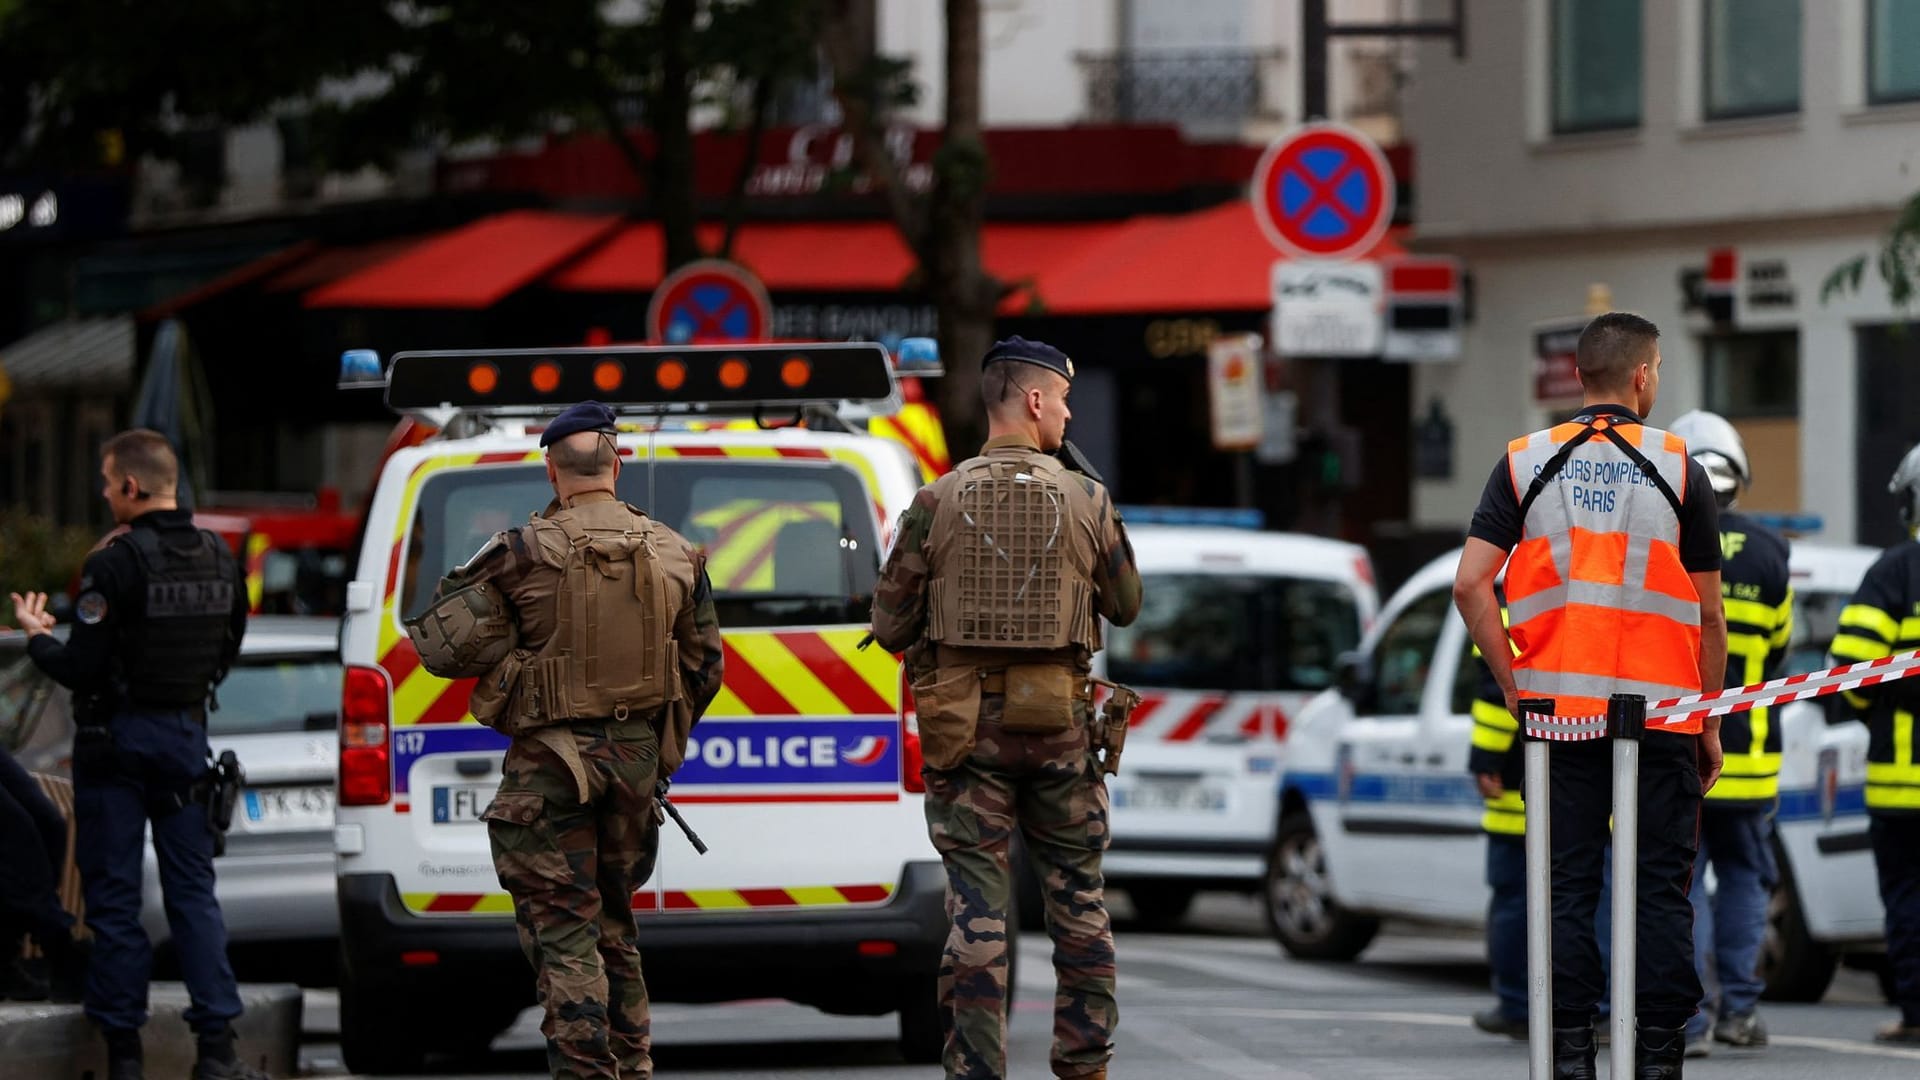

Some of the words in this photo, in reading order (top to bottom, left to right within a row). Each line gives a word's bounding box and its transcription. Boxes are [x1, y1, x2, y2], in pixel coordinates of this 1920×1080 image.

[1533, 459, 1592, 482] SEURS
[1573, 486, 1616, 513] PARIS
[682, 735, 837, 768] POLICE
